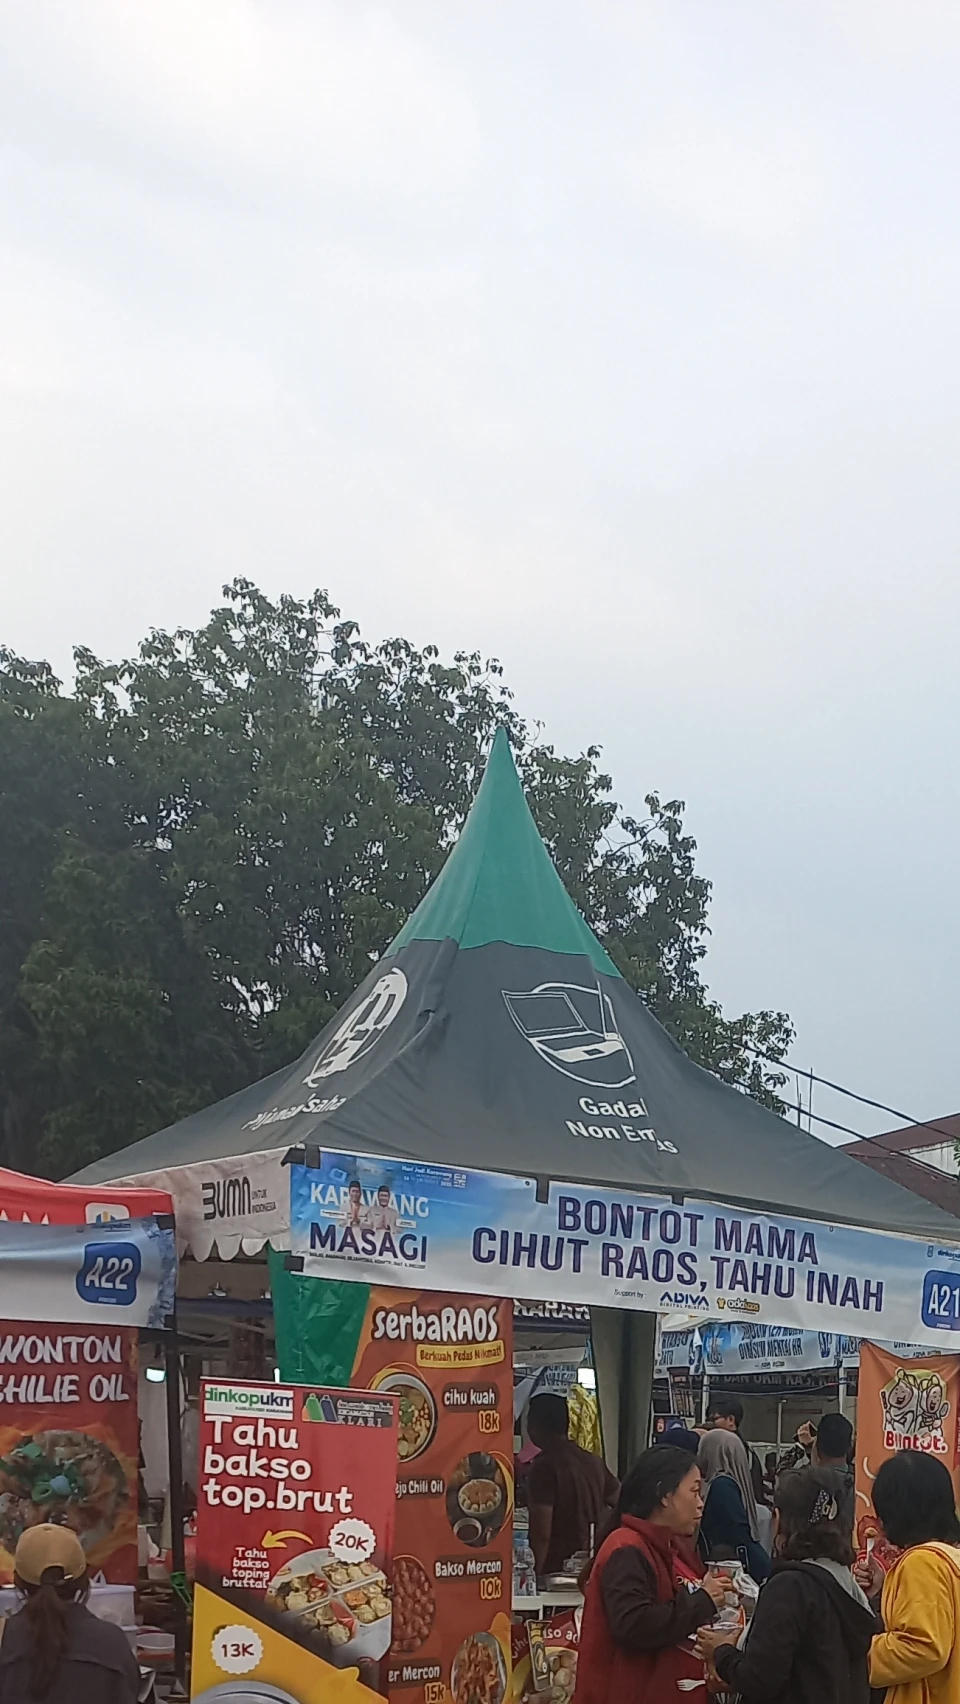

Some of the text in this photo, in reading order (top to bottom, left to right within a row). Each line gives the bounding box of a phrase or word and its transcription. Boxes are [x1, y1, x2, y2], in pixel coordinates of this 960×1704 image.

[565, 1119, 621, 1140] Non
[558, 1195, 819, 1265] BONTOT MAMA
[309, 1221, 429, 1263] MASAGI
[84, 1256, 134, 1291] A22
[472, 1226, 590, 1274] CIHUT
[710, 1256, 795, 1299] TAHU
[806, 1270, 884, 1312] INAH
[927, 1283, 960, 1319] A21
[373, 1305, 499, 1342] serbaRAOS
[420, 1349, 452, 1362] Berkuah
[453, 1351, 473, 1362] Pedas
[88, 1374, 130, 1402] OIL
[444, 1387, 496, 1406] cihu kuah
[204, 1415, 299, 1450] Tahu
[204, 1446, 312, 1481] bakso
[203, 1478, 353, 1514] top.brut
[408, 1479, 429, 1494] Chili
[430, 1479, 444, 1493] Oil
[334, 1532, 369, 1552] 20K
[232, 1556, 270, 1569] bakso
[235, 1547, 268, 1559] Tahu
[231, 1566, 270, 1583] toping
[435, 1558, 502, 1577] Bakso Mercon
[220, 1642, 255, 1658] 13K
[402, 1664, 441, 1681] Mercon
[424, 1682, 447, 1704] 15k
